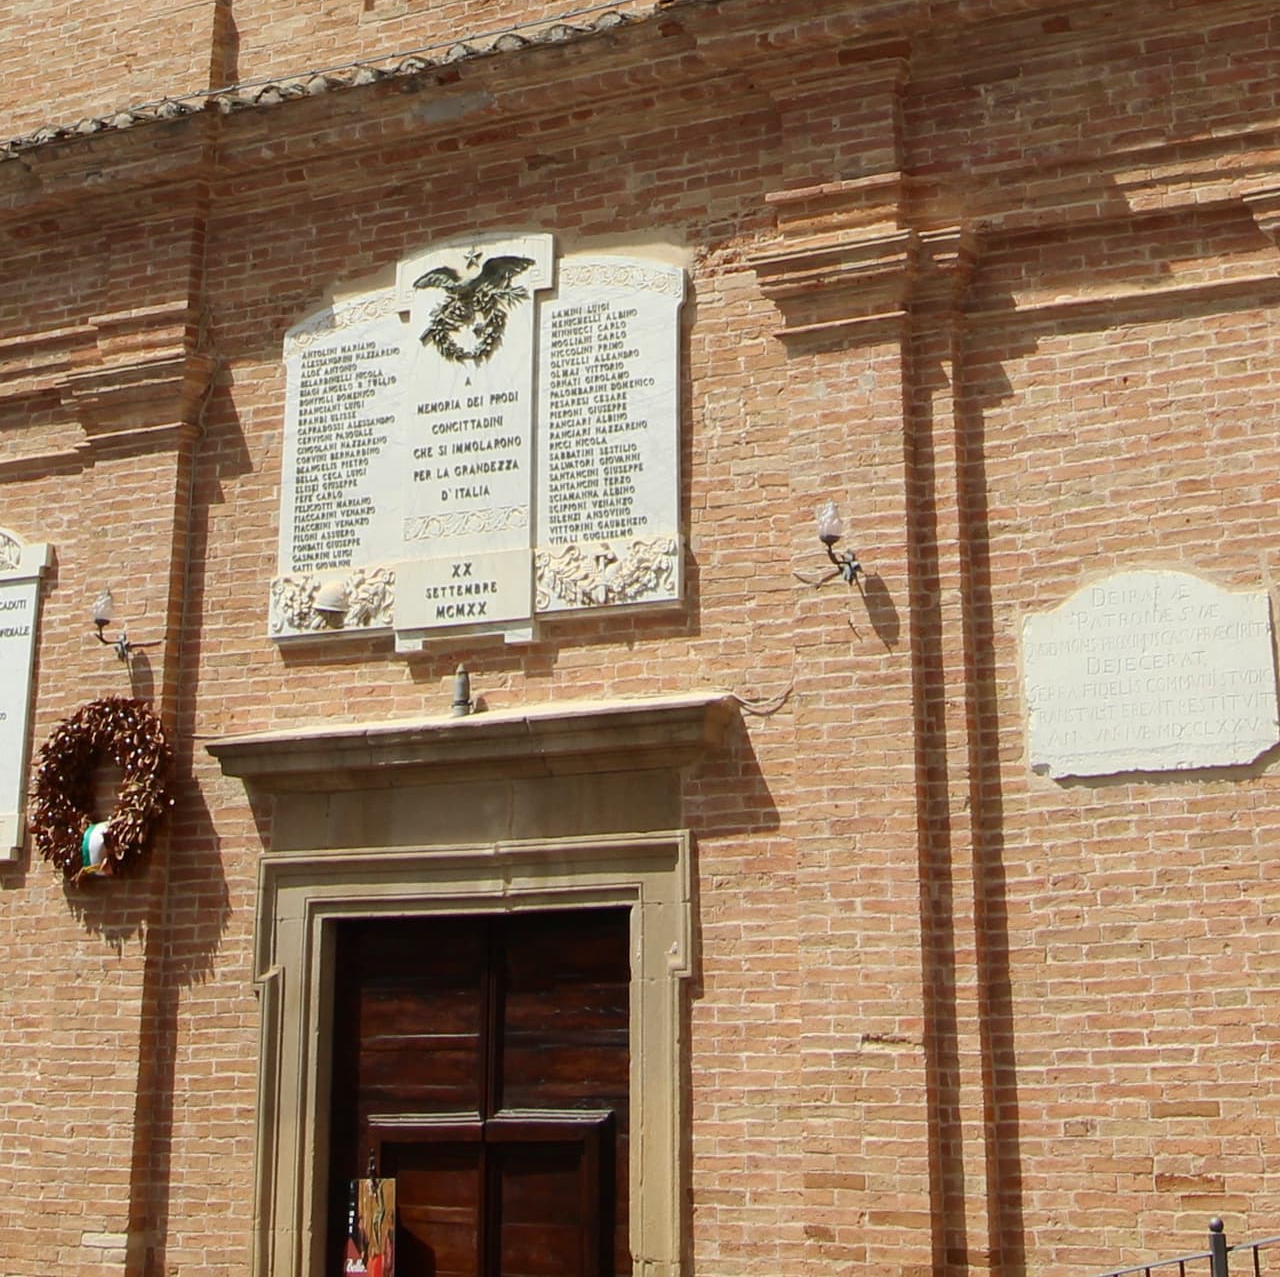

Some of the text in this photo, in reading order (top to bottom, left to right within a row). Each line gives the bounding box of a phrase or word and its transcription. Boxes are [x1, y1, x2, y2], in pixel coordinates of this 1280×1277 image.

[464, 375, 472, 387] A
[417, 390, 518, 415] MEMORIA DEI PRODI
[431, 415, 502, 435] CONCITTADINI
[413, 435, 521, 459] CHE SI IMMOLARONO
[413, 458, 518, 482] PER LA GRANDEZZA
[452, 562, 471, 576] XX
[426, 580, 497, 599] SETTEMBRE
[436, 602, 486, 619] MCMXX
